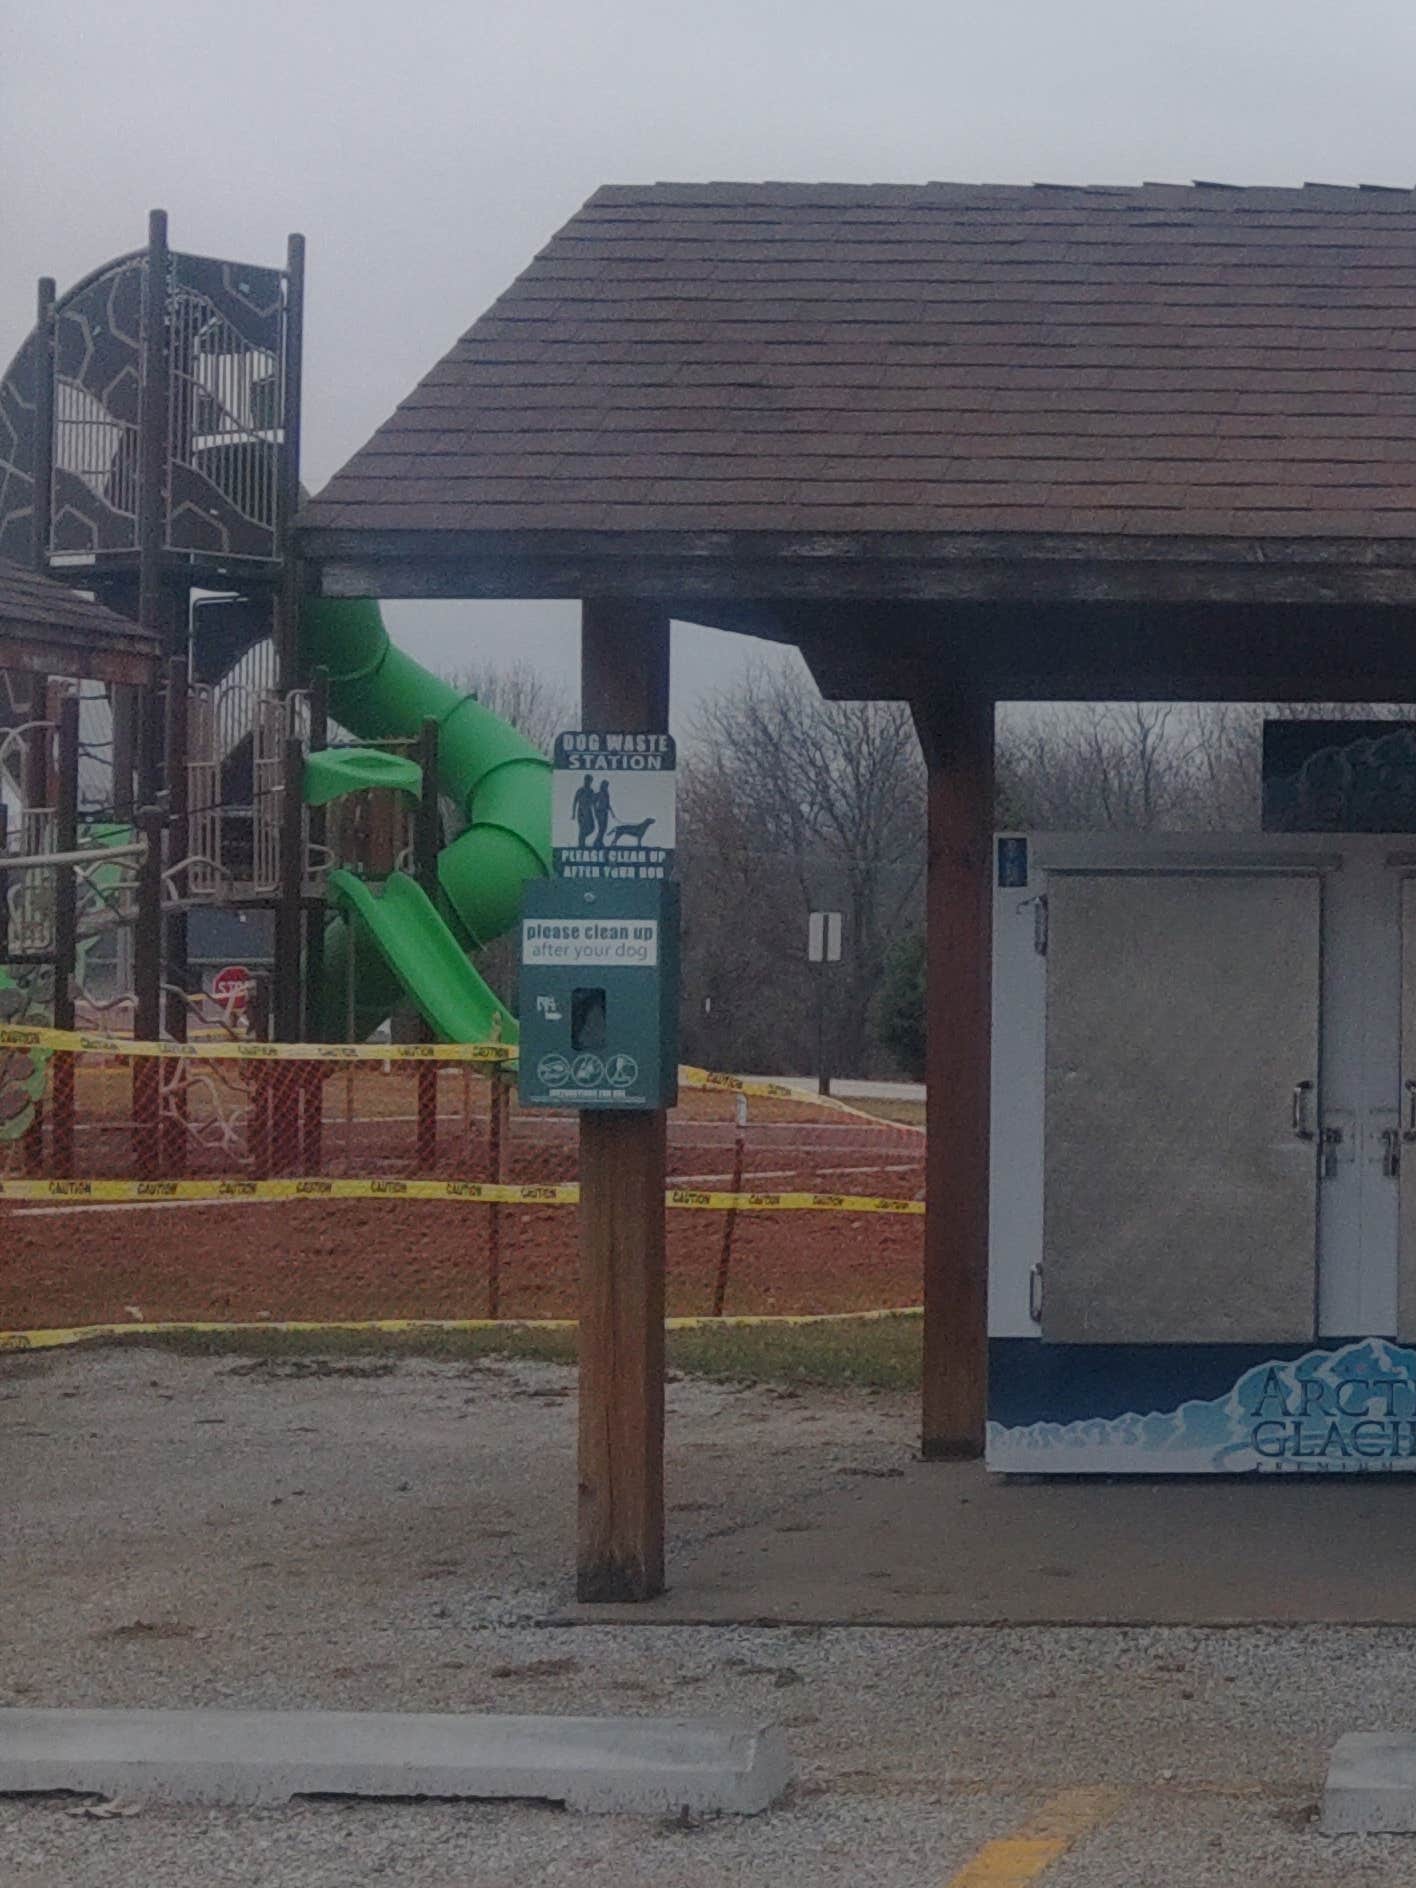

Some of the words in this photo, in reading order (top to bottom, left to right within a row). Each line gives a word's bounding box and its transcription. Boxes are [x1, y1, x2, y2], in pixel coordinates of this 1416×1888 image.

[563, 733, 599, 751] DOG
[606, 733, 668, 752] WASTE
[568, 754, 663, 770] STATION
[561, 849, 605, 863] PLEASE
[527, 924, 580, 941] please
[584, 923, 630, 940] clean
[633, 926, 653, 941] up
[532, 942, 572, 958] after
[574, 944, 613, 961] your
[615, 942, 649, 961] dog
[672, 1192, 711, 1205] CAUTION
